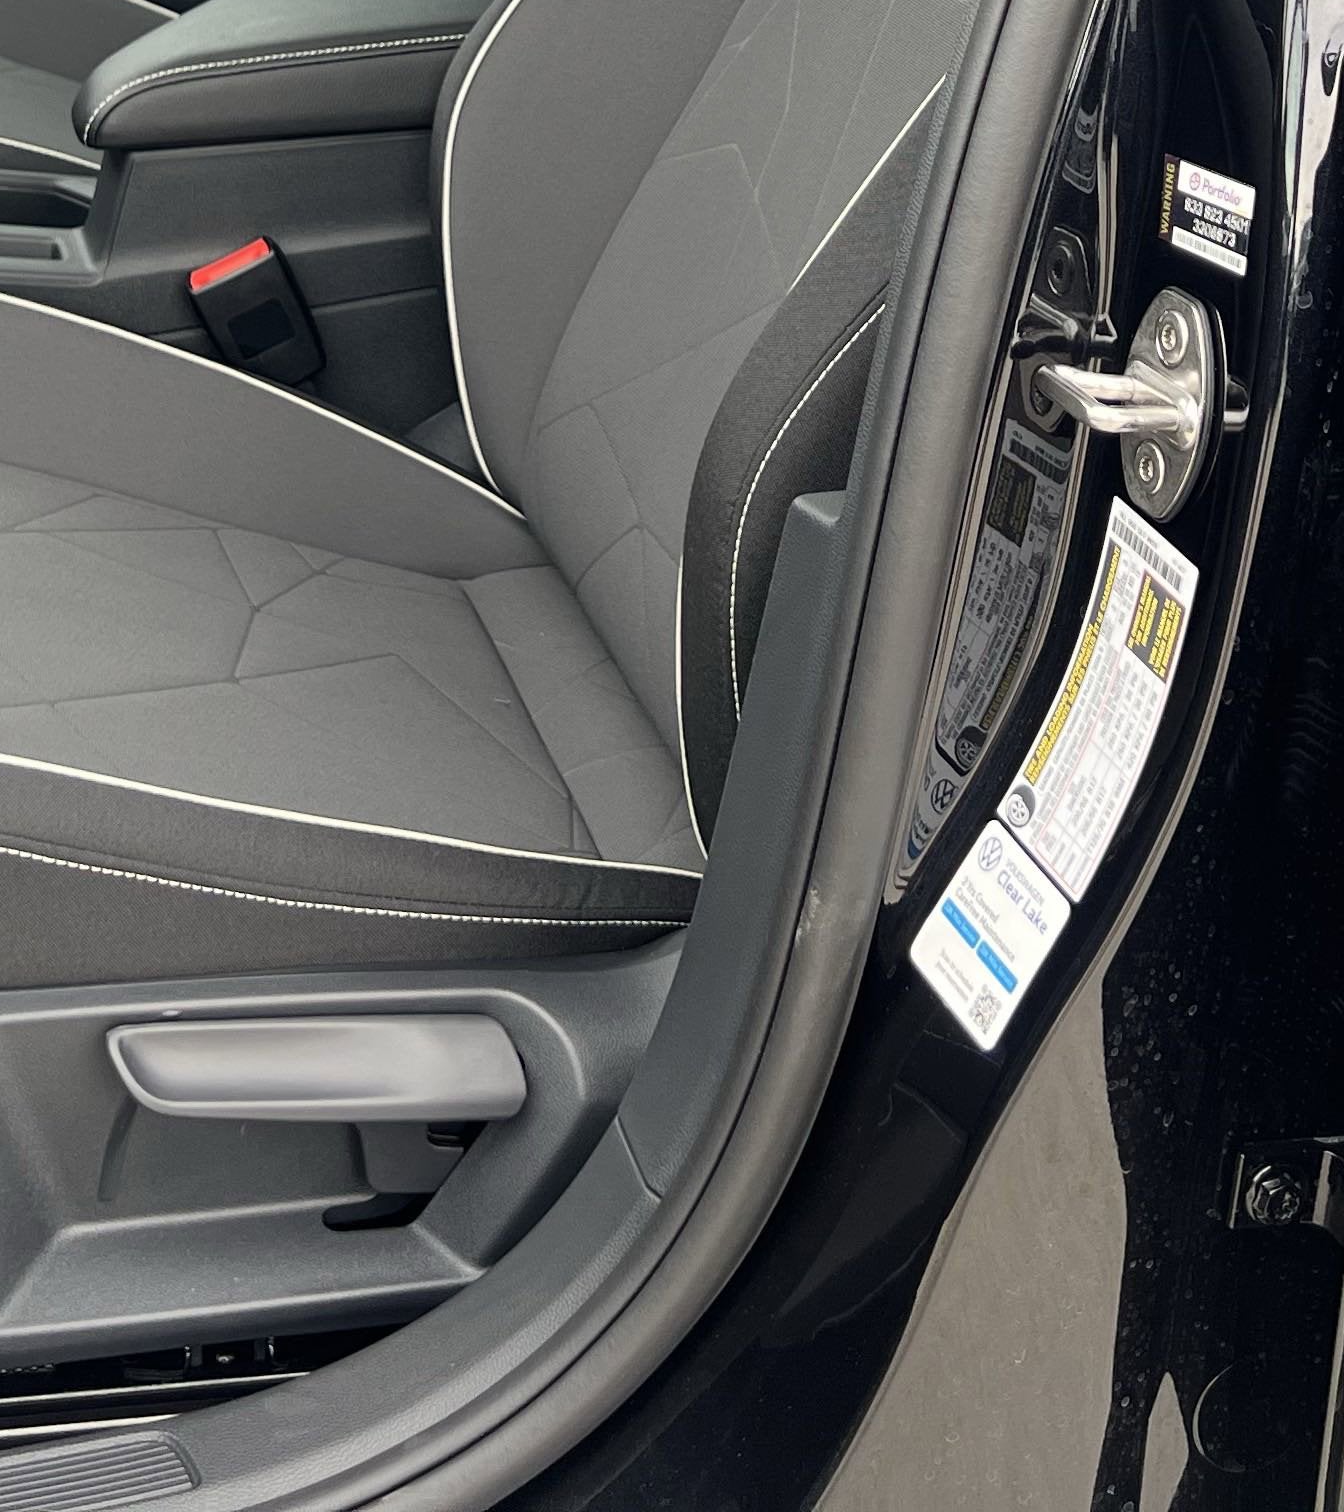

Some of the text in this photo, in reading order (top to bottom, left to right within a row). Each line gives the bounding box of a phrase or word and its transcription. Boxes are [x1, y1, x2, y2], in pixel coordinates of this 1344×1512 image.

[1159, 162, 1175, 234] WARNING
[1202, 176, 1241, 206] Portfolio
[997, 870, 1048, 935] Clear Lake
